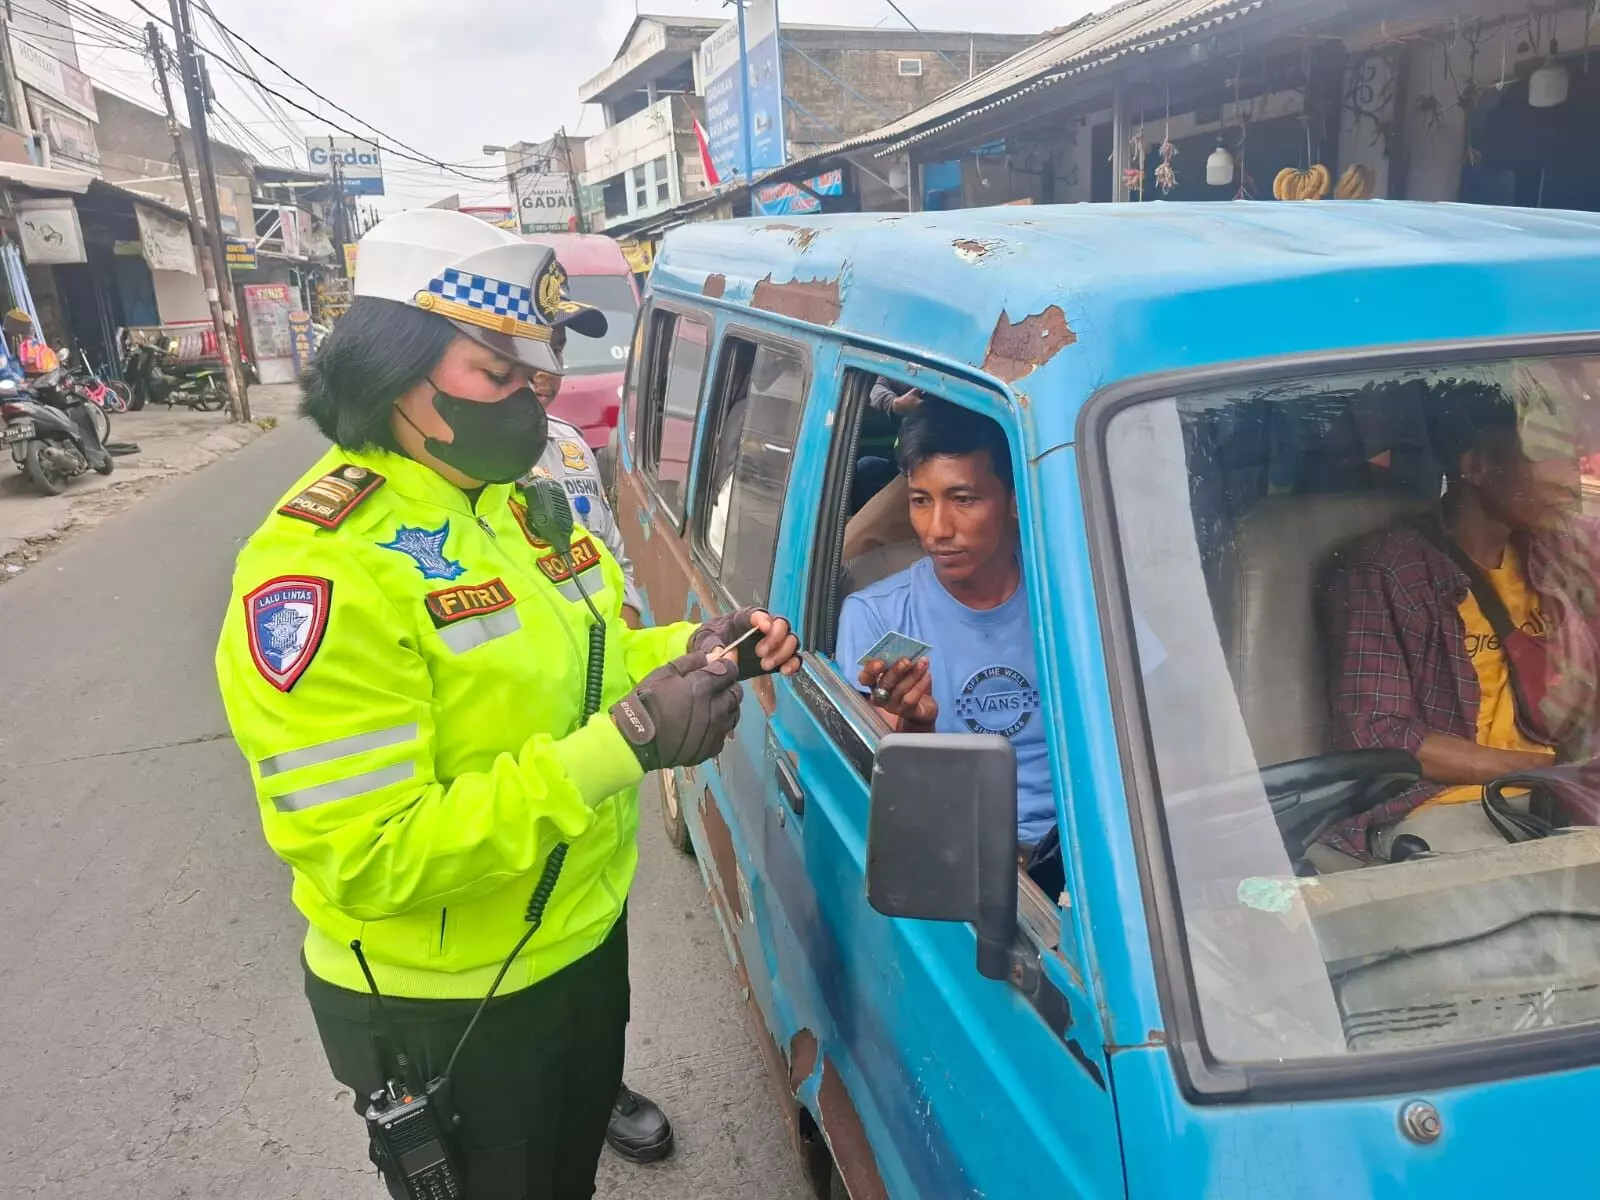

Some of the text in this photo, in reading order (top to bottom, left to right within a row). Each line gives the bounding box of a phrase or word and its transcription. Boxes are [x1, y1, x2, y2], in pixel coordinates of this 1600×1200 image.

[310, 147, 379, 165] Gadai
[521, 196, 573, 209] GADAI
[289, 497, 335, 518] POLISI
[259, 590, 312, 607] LALU LINTAS
[438, 584, 504, 615] FITRI
[966, 667, 1026, 691] OFF THE WALL
[974, 690, 1022, 713] VANS
[620, 701, 645, 733] EIGER
